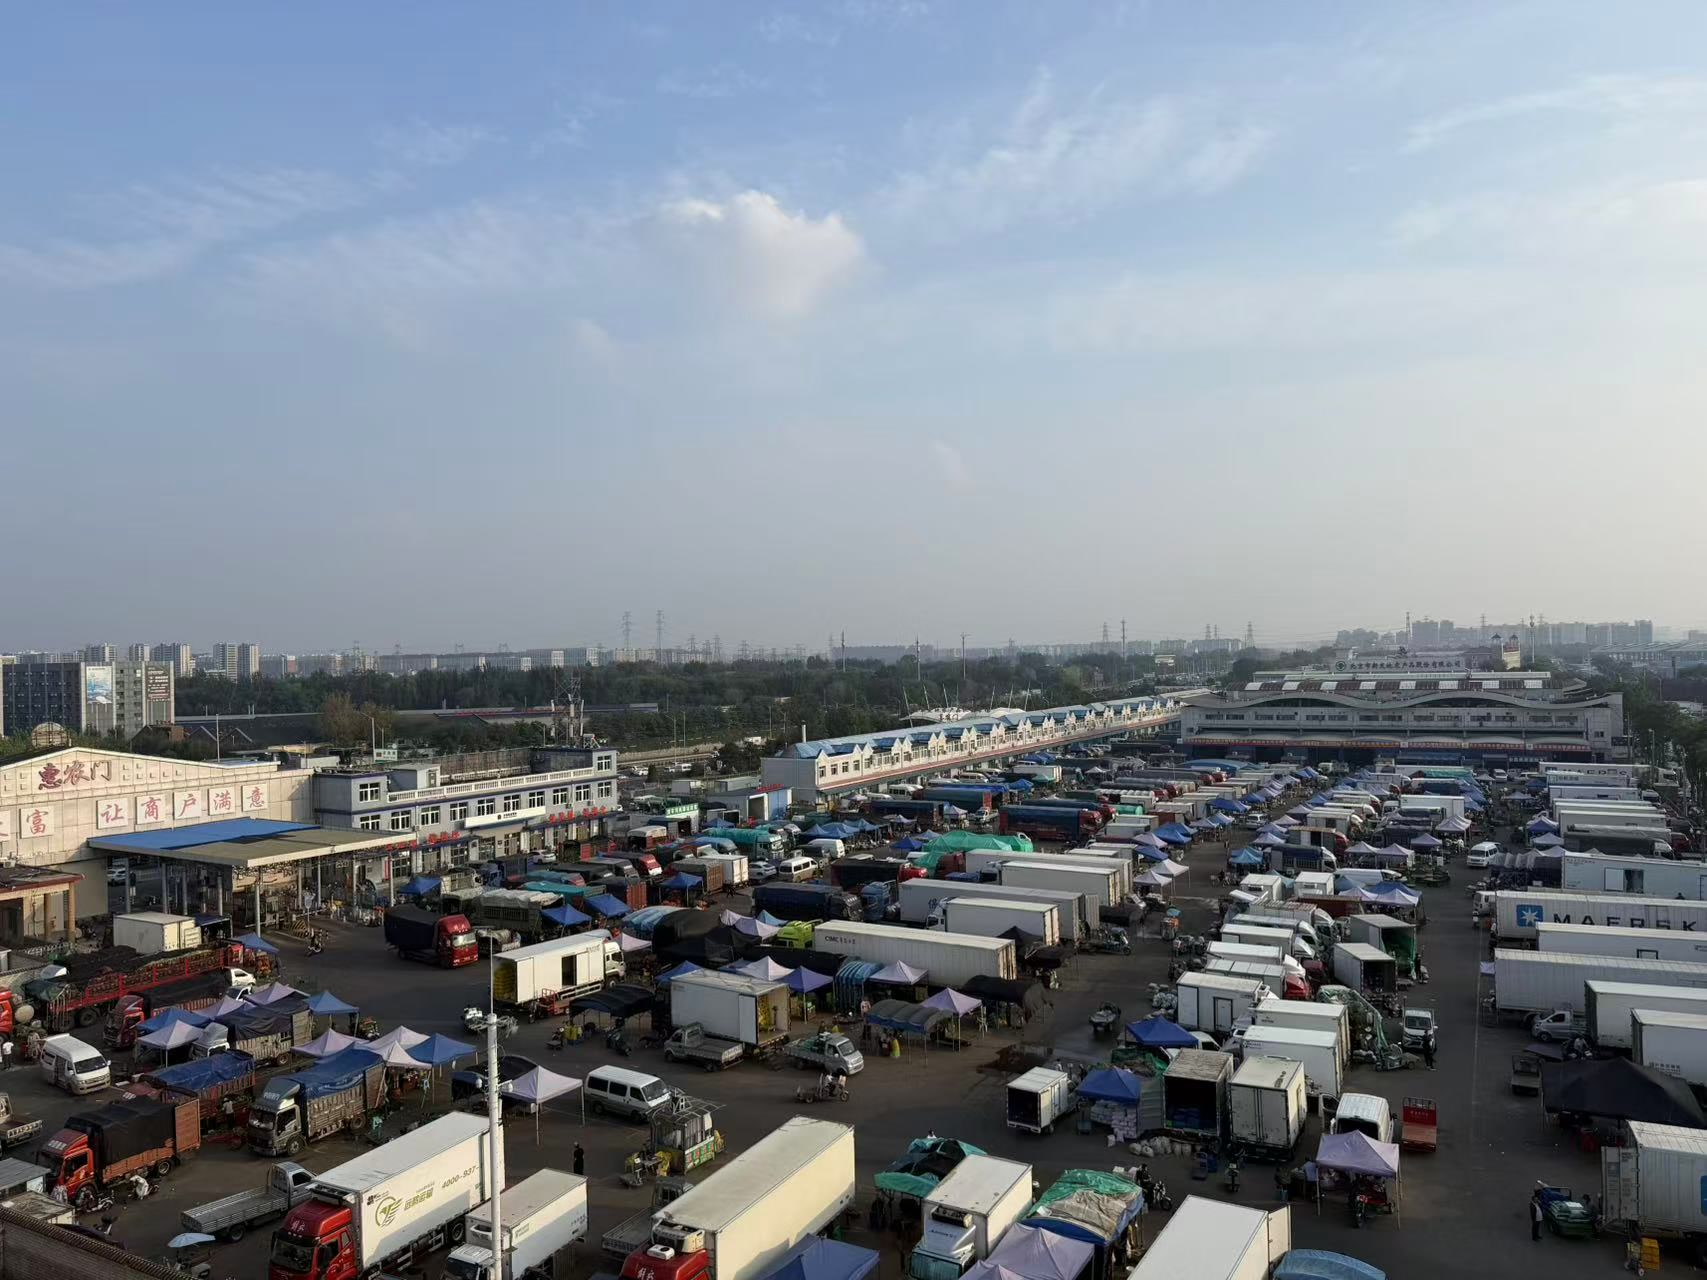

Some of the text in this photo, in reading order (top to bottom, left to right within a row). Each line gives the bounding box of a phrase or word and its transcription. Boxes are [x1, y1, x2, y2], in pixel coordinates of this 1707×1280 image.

[100, 786, 265, 823] 让商户满意
[1553, 913, 1697, 931] MAERSK
